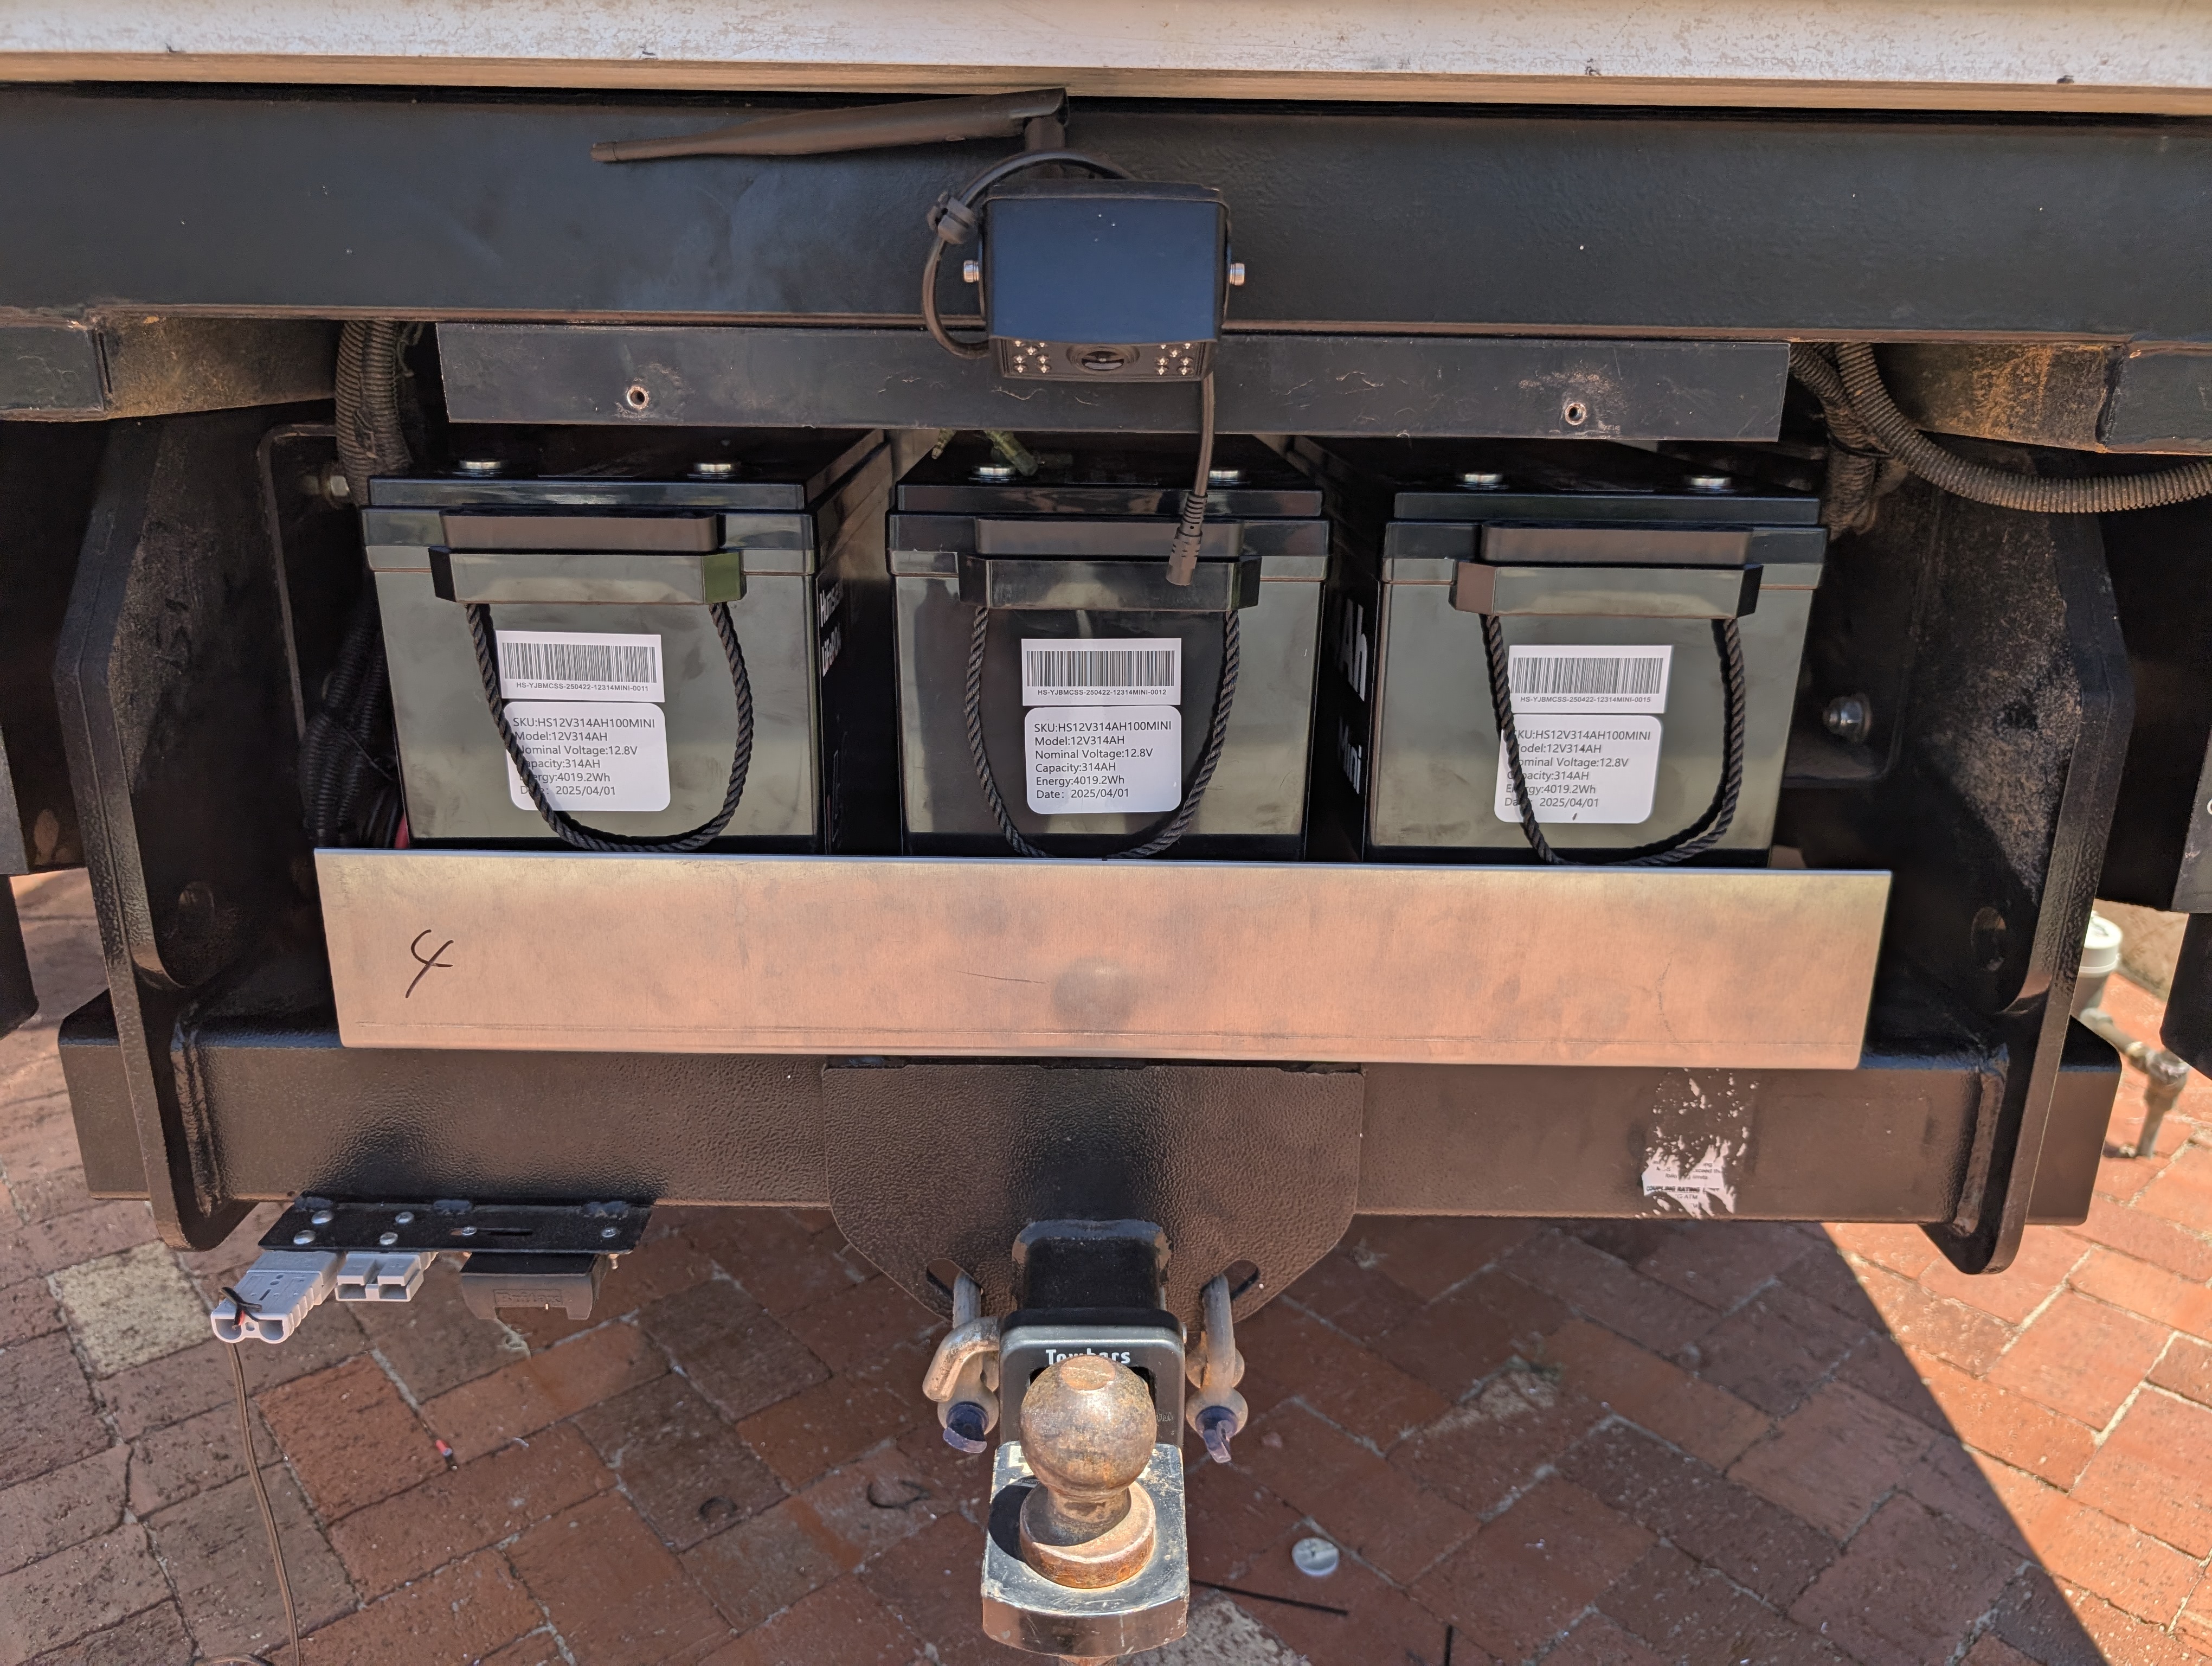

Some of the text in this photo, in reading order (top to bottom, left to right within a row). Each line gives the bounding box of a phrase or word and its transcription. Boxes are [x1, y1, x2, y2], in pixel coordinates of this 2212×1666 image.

[516, 682, 648, 691] HS-YJBMCSS-250422-12314MINI-0011
[513, 717, 655, 728] SKU:HS12V314AH100MINI
[1034, 721, 1172, 733] SKU:HS12V314AH100MINI
[515, 731, 608, 741] Model:12V314AH
[1034, 735, 1125, 746] Model:12V314AH
[1514, 729, 1651, 741] KU:HS12V314AH100MINI
[564, 746, 638, 757] Voltage:12.8V
[1517, 743, 1602, 753] odel:12V314AH
[1035, 748, 1154, 760] Nominal Voltage:12.8V
[527, 759, 601, 770] apacity:314AH
[1036, 762, 1116, 774] Capacity:314AH
[1519, 757, 1629, 769] ominal Voltage:12.8V
[1036, 775, 1125, 787] Energy:4019.2Wh
[520, 785, 616, 796] De: 2025/04/01
[1037, 788, 1129, 799] Date: 2025/04/01
[1539, 798, 1599, 808] 2025/04/01
[405, 929, 454, 998] 4
